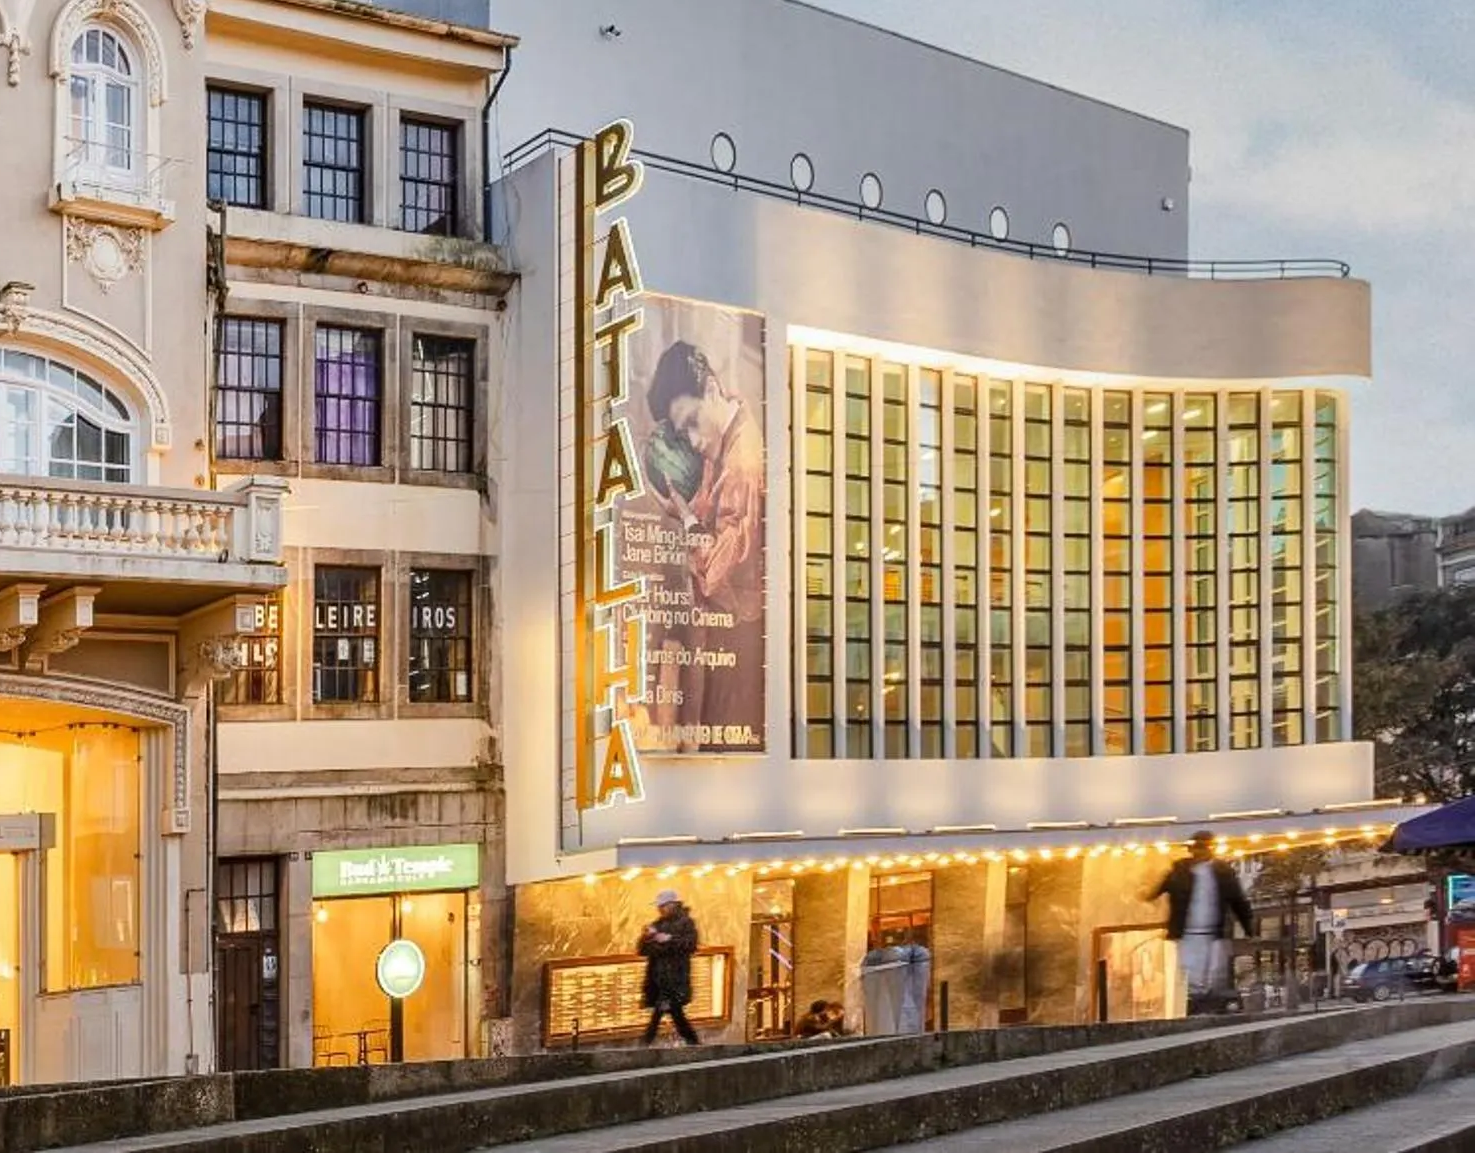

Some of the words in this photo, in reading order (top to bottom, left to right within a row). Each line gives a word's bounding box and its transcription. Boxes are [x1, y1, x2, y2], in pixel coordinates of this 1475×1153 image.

[593, 118, 646, 811] BATALHA
[623, 522, 645, 542] Tsai
[622, 543, 651, 563] Jane
[674, 611, 689, 625] no
[691, 607, 734, 628] Cinema
[676, 645, 691, 666] do
[693, 647, 736, 671] Arquivo
